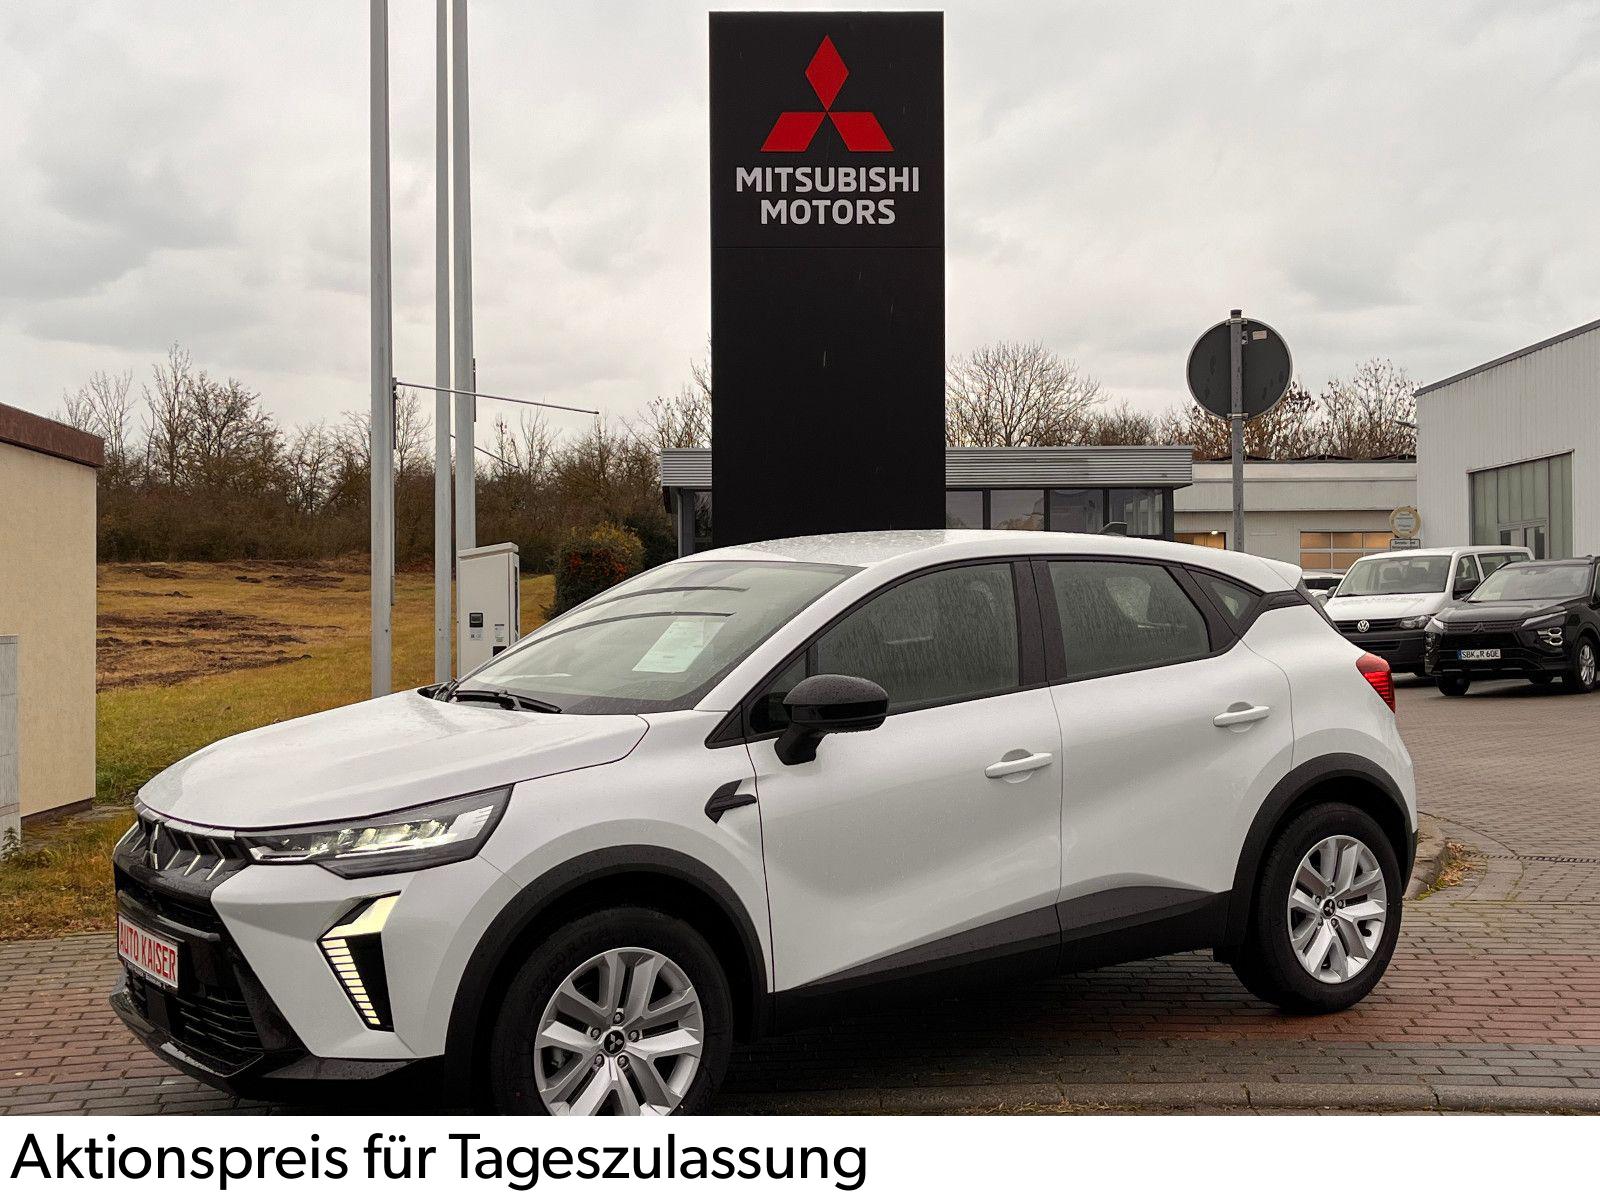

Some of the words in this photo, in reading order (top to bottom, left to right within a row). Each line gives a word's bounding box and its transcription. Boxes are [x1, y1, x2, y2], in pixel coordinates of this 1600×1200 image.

[736, 167, 919, 192] MITSUBISHI
[760, 199, 896, 225] MOTORS
[119, 921, 139, 961] AUTO
[141, 934, 176, 982] KAISER
